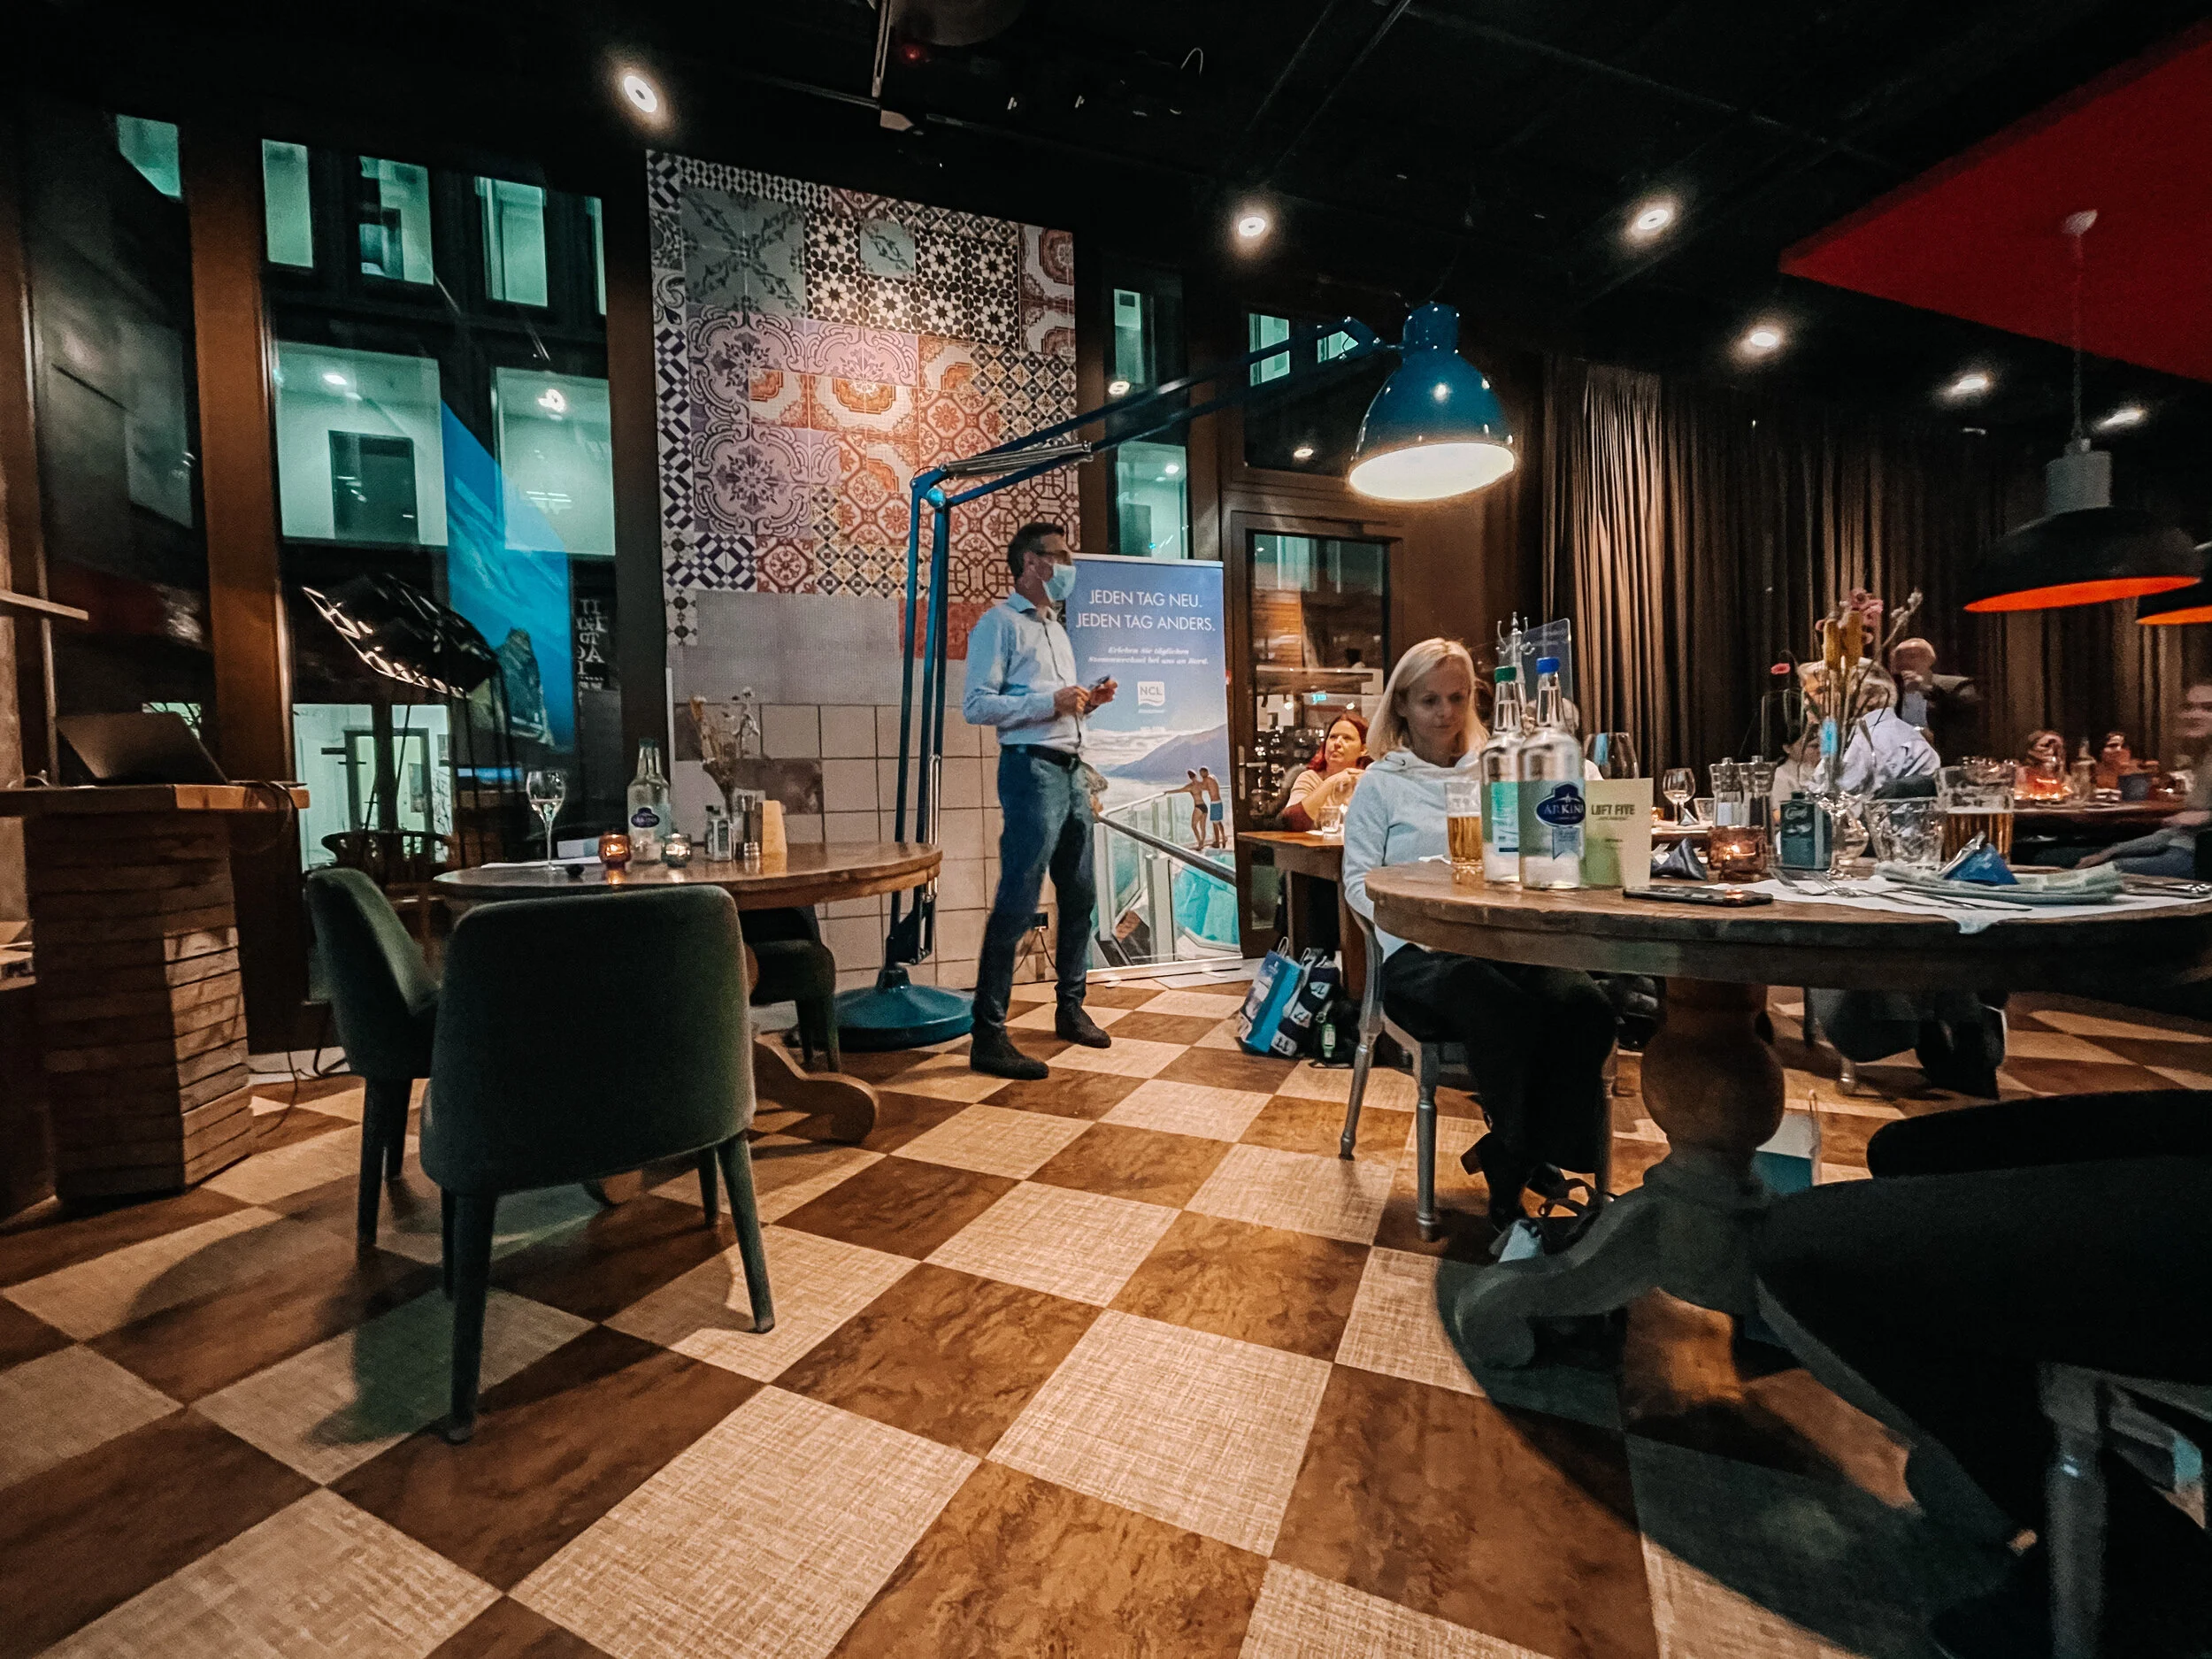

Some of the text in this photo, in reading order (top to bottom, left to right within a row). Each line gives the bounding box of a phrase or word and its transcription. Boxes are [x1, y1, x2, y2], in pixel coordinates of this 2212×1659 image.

[1088, 589, 1203, 609] JEDEN TAG NEU.
[1075, 612, 1216, 632] JEDEN TAG ANDERS.
[1140, 686, 1164, 696] NCL
